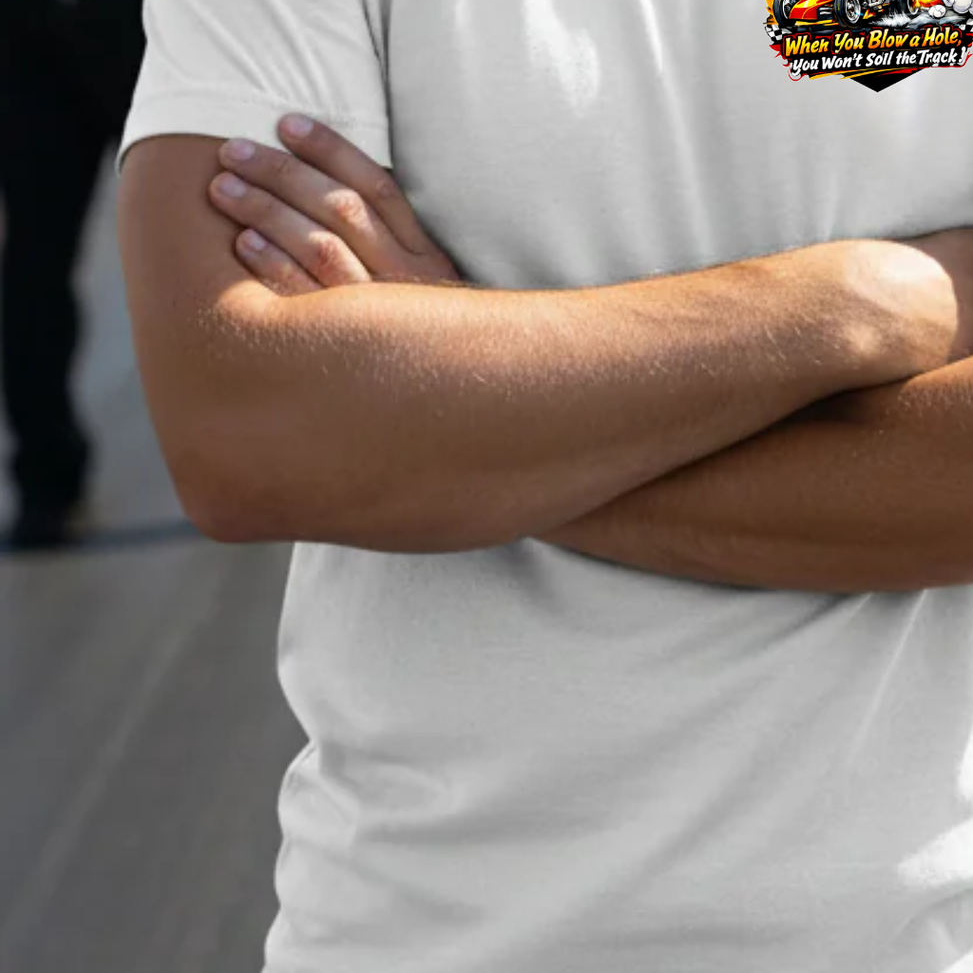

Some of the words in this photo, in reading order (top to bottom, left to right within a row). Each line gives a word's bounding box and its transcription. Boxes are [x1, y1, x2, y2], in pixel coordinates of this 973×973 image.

[785, 35, 829, 57] When
[834, 32, 865, 54] You
[867, 28, 909, 49] Blow
[909, 35, 920, 47] a
[921, 26, 962, 47] Hole,
[821, 53, 863, 70] Won't
[896, 50, 917, 65] the
